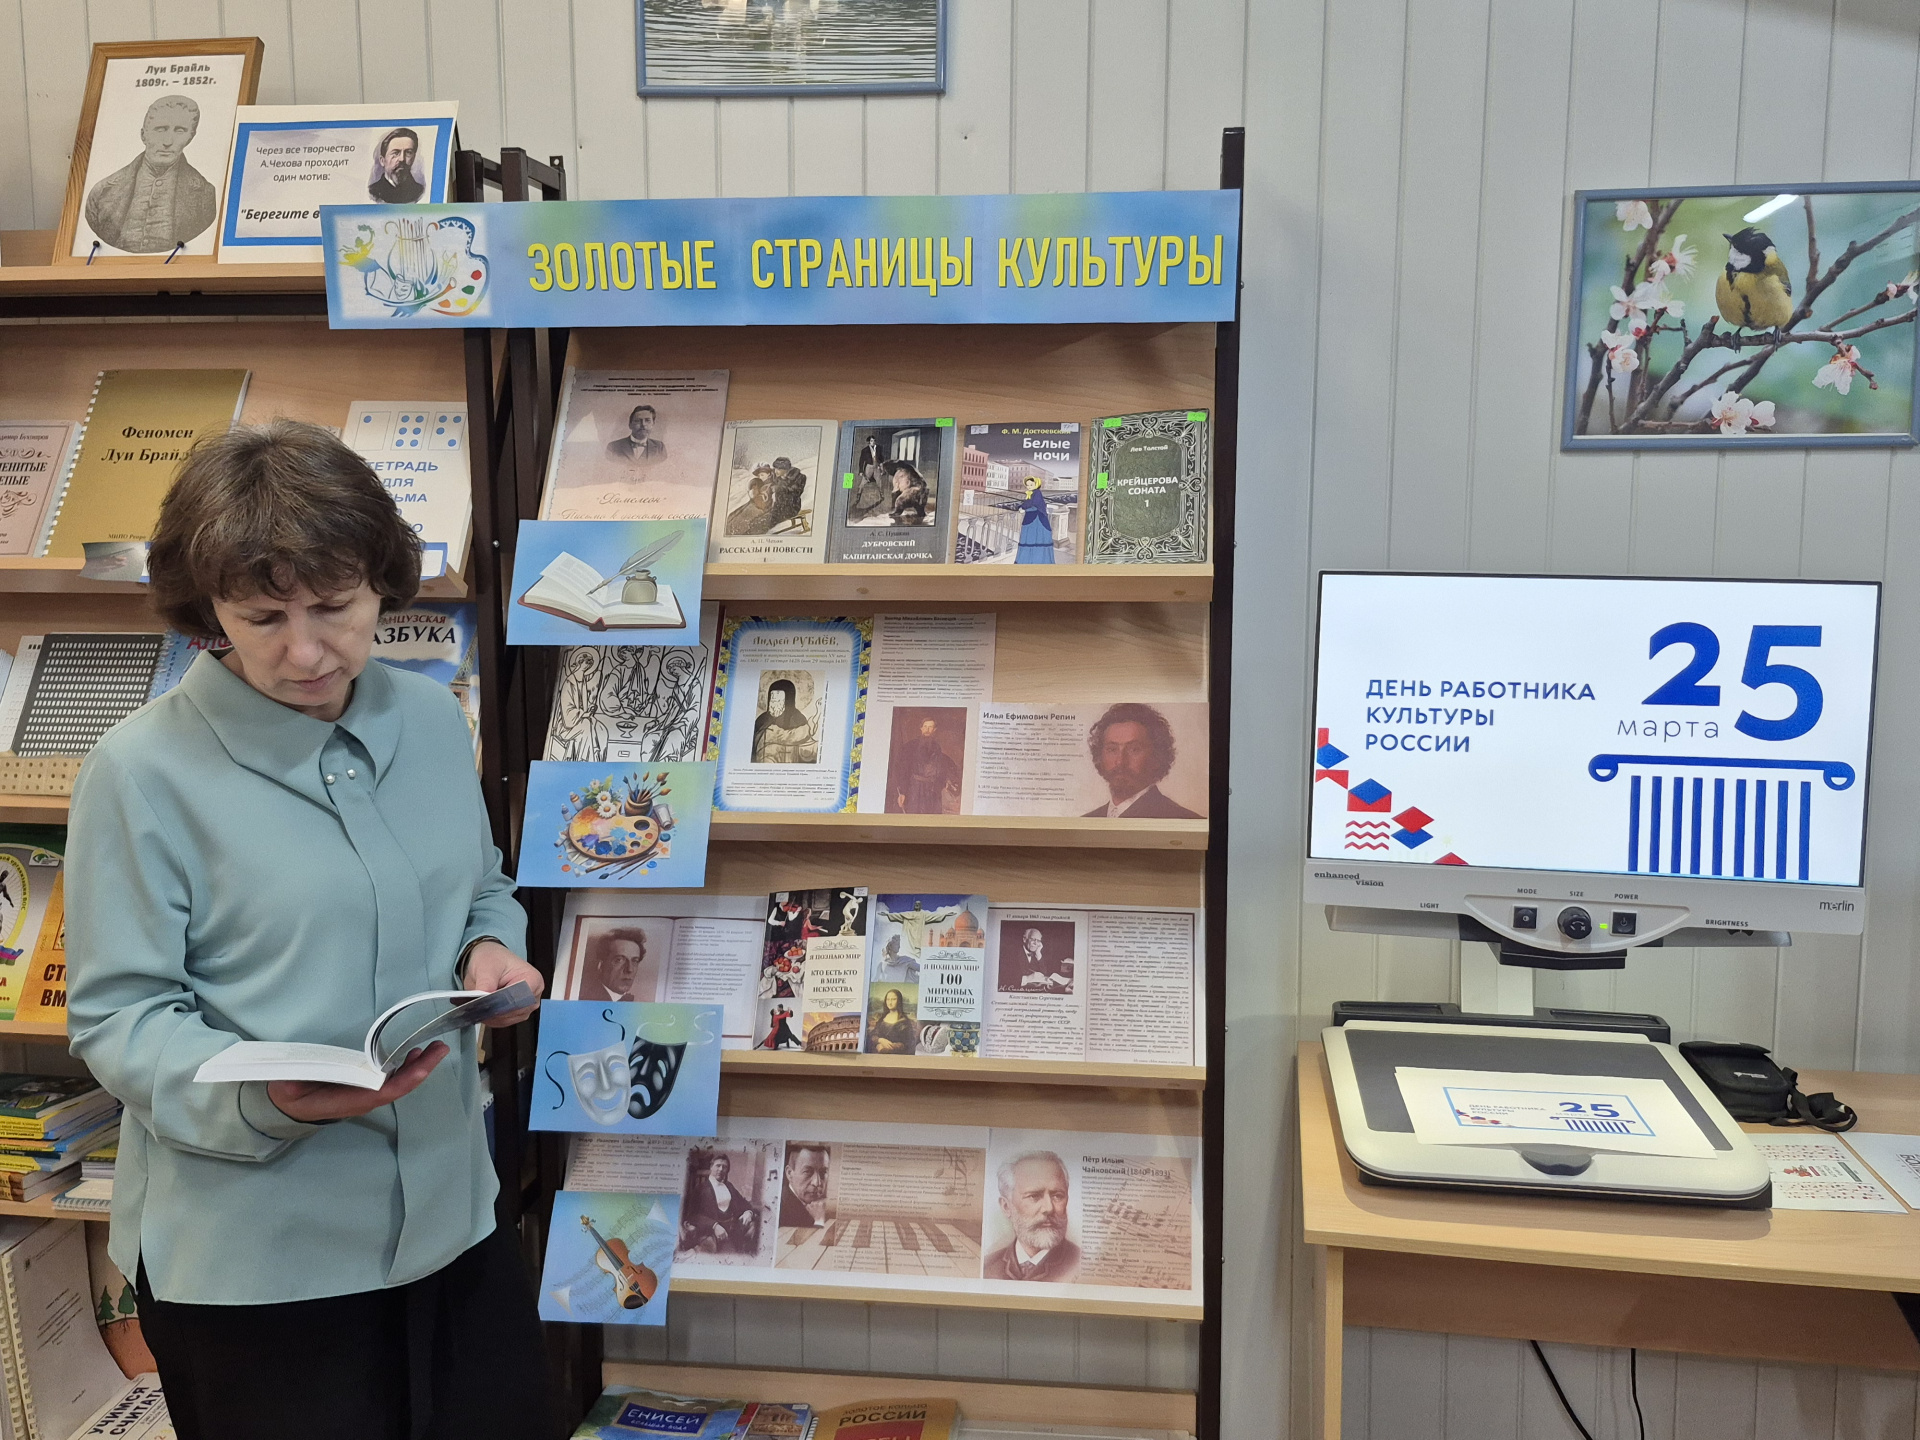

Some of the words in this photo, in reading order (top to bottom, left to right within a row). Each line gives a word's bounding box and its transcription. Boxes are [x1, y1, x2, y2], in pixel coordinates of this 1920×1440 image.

[145, 65, 167, 75] Луи
[170, 63, 211, 74] Брайль
[135, 78, 169, 87] 1809г.
[182, 76, 217, 86] 1852г.
[256, 146, 283, 156] Через
[303, 145, 355, 155] творчество
[260, 159, 303, 168] А.Чехова
[304, 159, 349, 169] проходит
[273, 174, 297, 182] один
[298, 173, 331, 181] мотив:
[241, 209, 309, 222] "Берегите
[527, 240, 717, 292] ЗОЛОТЫЕ
[751, 236, 974, 298] СТРАНИЦЫ
[998, 234, 1224, 289] КУЛЬТУРЫ
[121, 426, 193, 440] Феномен
[1022, 437, 1071, 449] Белые
[1143, 444, 1169, 452] Толстой
[101, 449, 134, 464] Луи
[138, 448, 191, 464] Брайл
[1033, 451, 1070, 461] ночи
[382, 478, 414, 488] ДЛЯ
[1117, 476, 1178, 487] КРЕЙЦЕРОВА
[1128, 486, 1166, 495] СОНАТА
[1144, 499, 1149, 508] 1
[861, 539, 916, 548] ДУБРОВСКИЙ
[719, 546, 762, 554] РАССКАЗЫ
[772, 546, 813, 554] ПОВЕСТИ
[904, 552, 933, 560] ДОЧКА
[753, 635, 790, 648] Андрей
[1640, 621, 1825, 742] 25
[1365, 679, 1432, 700] ДЕНЬ
[1440, 681, 1597, 701] РАБОТНИКА
[983, 712, 1004, 720] Илья
[1005, 712, 1049, 721] Ефимович
[1366, 706, 1495, 727] КУЛЬТУРЫ
[1616, 719, 1720, 743] марта
[1365, 733, 1470, 753] РОССИИ
[1314, 871, 1360, 880] enhanced
[1355, 879, 1384, 887] vision
[1705, 919, 1749, 928] BRIGHTNESS
[963, 964, 980, 972] МИР
[939, 973, 963, 986] 100
[927, 988, 974, 996] МИРОВЫХ
[924, 996, 975, 1005] ШЕДЕВРОВ
[1559, 1102, 1620, 1118] 25
[1082, 1155, 1100, 1164] Пётр
[1082, 1166, 1126, 1175] Чайковский
[88, 1386, 150, 1434] УЧИМСЯ
[109, 1387, 164, 1436] СЧИТАТЬ
[627, 1408, 700, 1425] ЕНИСЕЙ
[839, 1410, 926, 1427] РОССИИ
